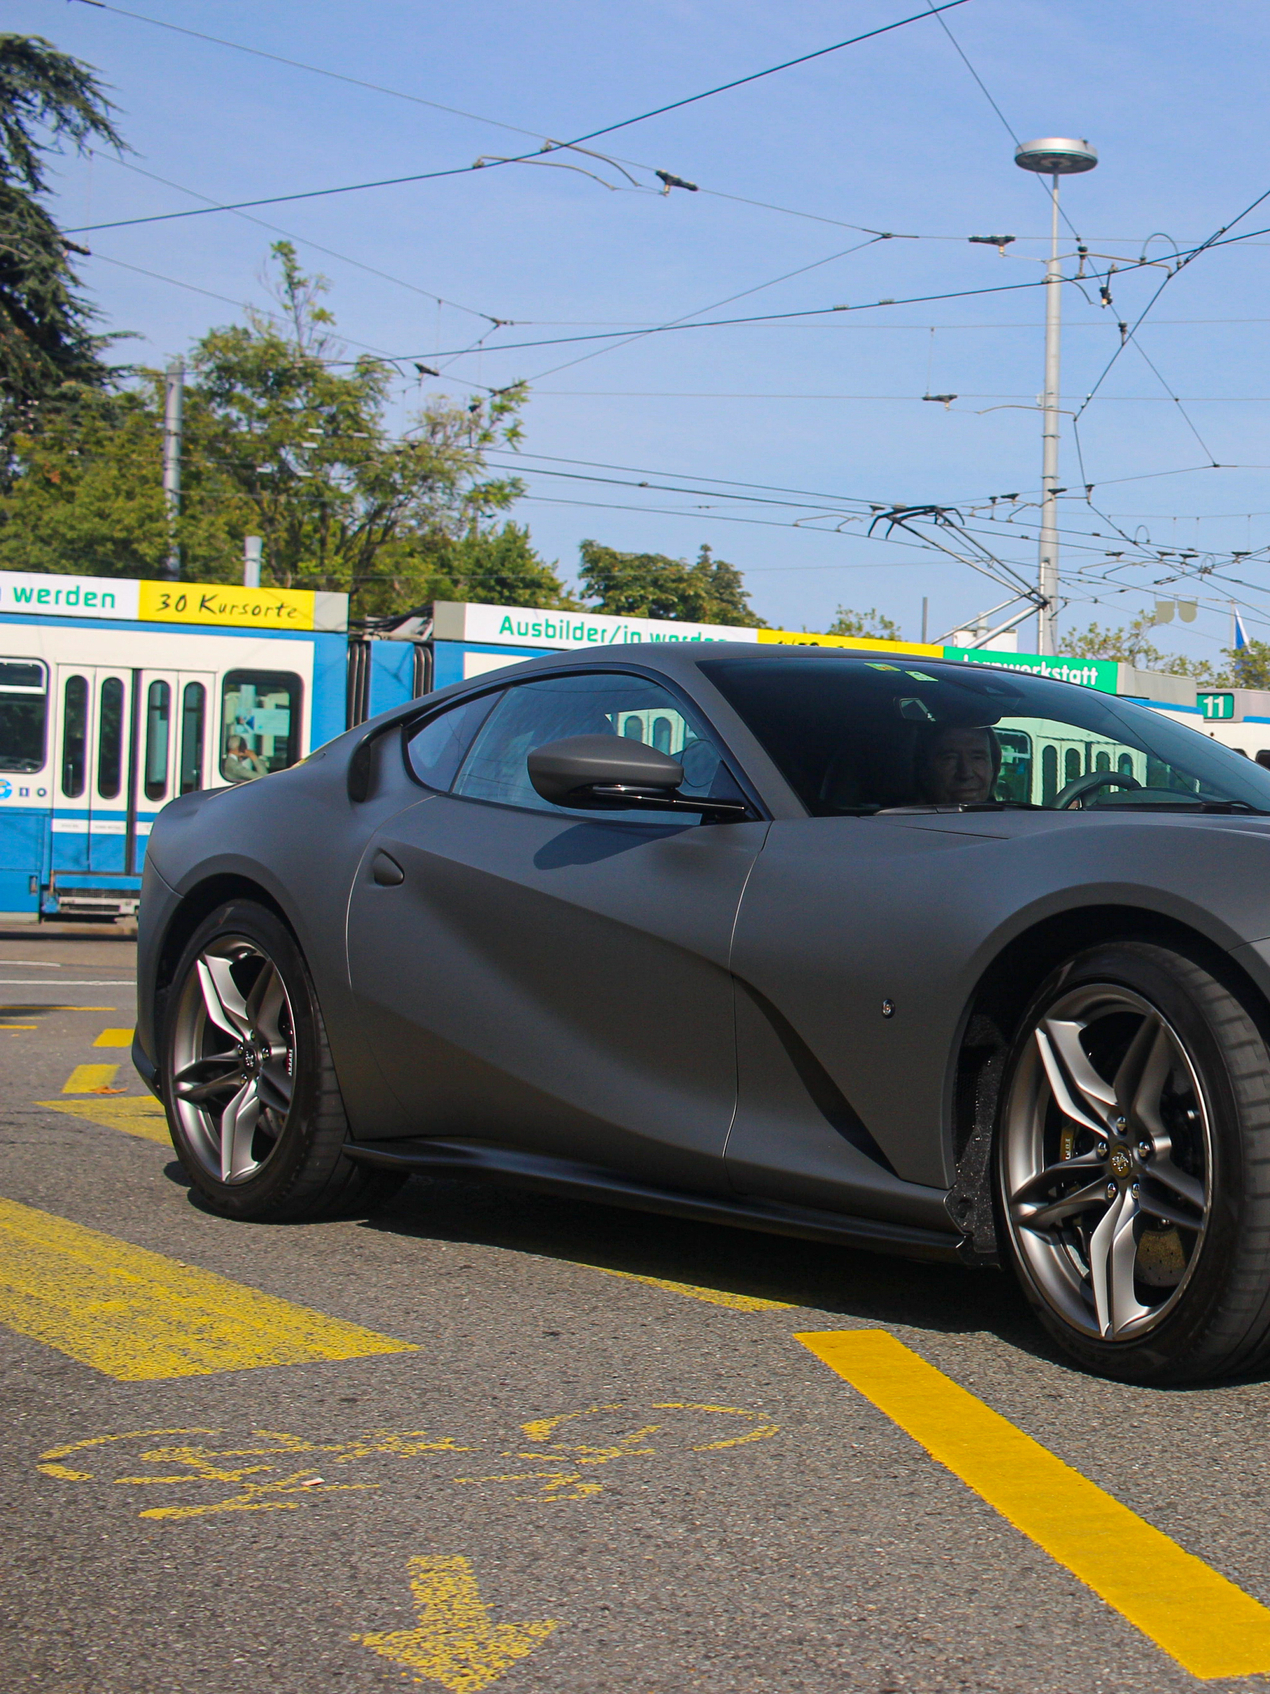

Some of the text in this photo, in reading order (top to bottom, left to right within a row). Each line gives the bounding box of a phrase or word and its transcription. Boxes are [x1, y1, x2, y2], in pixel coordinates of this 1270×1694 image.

[14, 585, 116, 609] werden
[156, 593, 298, 619] 30 Kursorte
[499, 615, 642, 644] Ausbilder/in
[1202, 695, 1225, 718] 11
